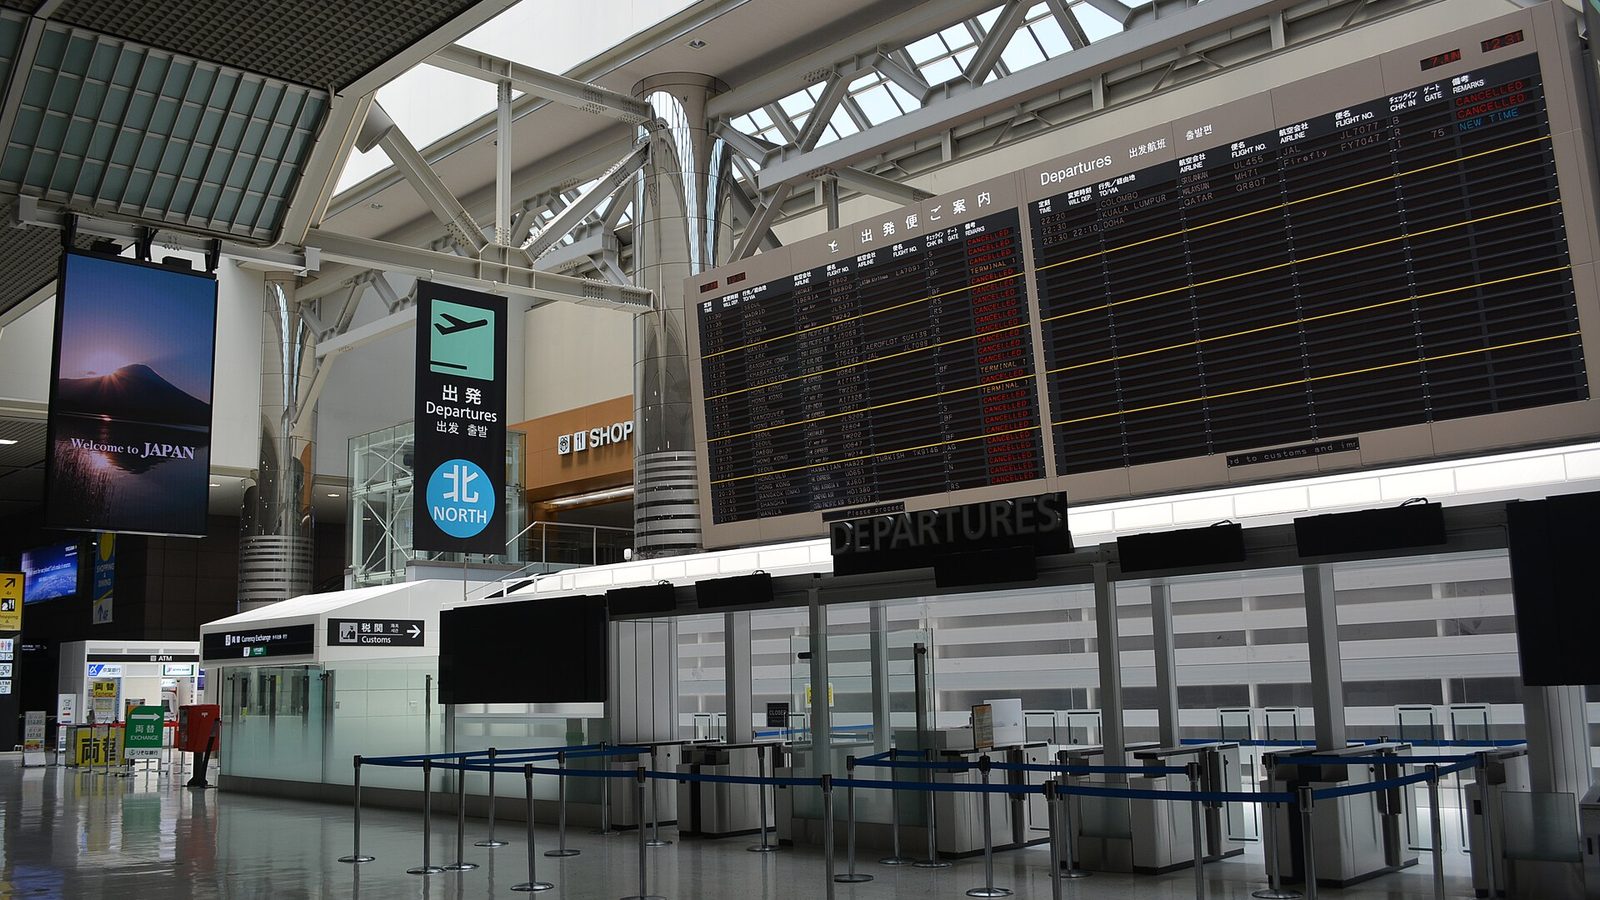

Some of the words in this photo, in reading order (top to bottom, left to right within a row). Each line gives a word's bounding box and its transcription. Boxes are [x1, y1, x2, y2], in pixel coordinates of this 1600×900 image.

[1423, 84, 1440, 95] ゲート
[1452, 80, 1484, 95] REMARKS
[1455, 80, 1525, 107] CANCELLED
[1388, 90, 1418, 105] チェックイン
[1424, 92, 1442, 104] GATE
[1390, 102, 1407, 112] CHK
[1408, 100, 1416, 108] IN
[1456, 93, 1526, 120] CANCELLED
[1334, 110, 1351, 121] 便名
[1336, 114, 1360, 129] FLIGHT
[1362, 111, 1374, 121] NO.
[1392, 116, 1400, 126] B
[1458, 118, 1482, 132] NEW
[1489, 106, 1519, 123] TIME
[1185, 124, 1212, 141] 출발편
[1278, 122, 1309, 137] 航空会社
[1340, 122, 1379, 140] JL7077
[1394, 128, 1401, 138] R
[1432, 128, 1445, 140] 75
[1280, 131, 1306, 144] AIRLINE
[1341, 134, 1381, 152] FY7047
[1128, 138, 1167, 159] 出发航班
[1230, 141, 1246, 152] 便名
[1232, 146, 1254, 159] FLIGHT
[1254, 143, 1266, 154] NO.
[1282, 146, 1302, 158] JAL
[1178, 152, 1206, 168] 航空会社
[1232, 156, 1264, 171] UL455
[1284, 149, 1329, 168] Firefly
[1040, 155, 1112, 186] Departures
[1180, 162, 1204, 174] AIRLINE
[1234, 168, 1259, 182] MH71
[1098, 186, 1119, 199] TO/VIA
[1236, 178, 1267, 193] QR807
[1068, 198, 1080, 208] WILL
[1080, 194, 1093, 204] DEP.
[1100, 192, 1139, 208] COLOMBO
[1102, 204, 1128, 219] KUALA
[1134, 194, 1167, 211] LUMPUR
[1184, 192, 1214, 208] QATAR
[861, 191, 992, 244] 出発便ご案内
[1038, 206, 1052, 217] TIME
[1040, 212, 1066, 226] 22:20
[1103, 218, 1125, 230] DOHA
[965, 226, 986, 237] REMARKS
[1042, 222, 1068, 237] 22:30
[1043, 232, 1068, 247] 22:30
[1072, 224, 1099, 239] 22:10
[926, 240, 938, 250] CHK
[938, 238, 944, 246] IN
[948, 234, 959, 243] GATE
[967, 229, 1009, 246] CANCELLED
[892, 248, 908, 259] FLIGHT
[909, 246, 918, 254] NO.
[968, 239, 1010, 256] CANCELLED
[858, 258, 874, 270] AIRLINE
[969, 249, 1011, 266] CANCELLED
[826, 268, 841, 280] FLIGHT
[842, 266, 850, 276] NO.
[970, 262, 1007, 275] TERMINAL
[794, 279, 810, 288] AIRLINE
[970, 269, 1013, 284] CANCELLED
[972, 279, 1014, 295] CANCELLED
[972, 289, 1015, 304] CANCELLED
[974, 300, 1016, 315] CANCELLED
[975, 308, 1018, 325] CANCELLED
[976, 318, 1019, 334] CANCELLED
[978, 330, 1020, 345] CANCELLED
[978, 340, 1021, 354] CANCELLED
[980, 350, 1022, 364] CANCELLED
[980, 360, 1017, 374] TERMINAL
[981, 370, 1024, 384] CANCELLED
[442, 384, 482, 406] 出発
[982, 382, 1020, 395] TERMINAL
[983, 390, 1026, 404] CANCELLED
[426, 401, 498, 422] Departures
[984, 400, 1027, 414] CANCELLED
[985, 411, 1028, 424] CANCELLED
[436, 420, 460, 436] 出发
[467, 424, 488, 438] 출발
[589, 420, 633, 448] SHOP
[986, 422, 1029, 434] CANCELLED
[988, 432, 1030, 444] CANCELLED
[71, 438, 124, 454] Welcome
[127, 445, 139, 455] to
[141, 442, 196, 460] JAPAN
[988, 442, 1031, 454] CANCELLED
[1246, 456, 1258, 464] to
[1264, 449, 1307, 461] customs
[1314, 444, 1333, 454] and
[876, 452, 905, 464] TURKISH
[990, 452, 1032, 464] CANCELLED
[991, 462, 1034, 474] CANCELLED
[442, 464, 479, 503] 北
[992, 472, 1034, 484] CANCELLED
[434, 506, 487, 524] NORTH
[876, 503, 904, 514] proceed
[832, 492, 1059, 555] DEPARTURES
[362, 622, 384, 633] 税関
[256, 634, 271, 642] Exchange
[361, 636, 392, 645] Customs
[135, 724, 155, 734] 両替
